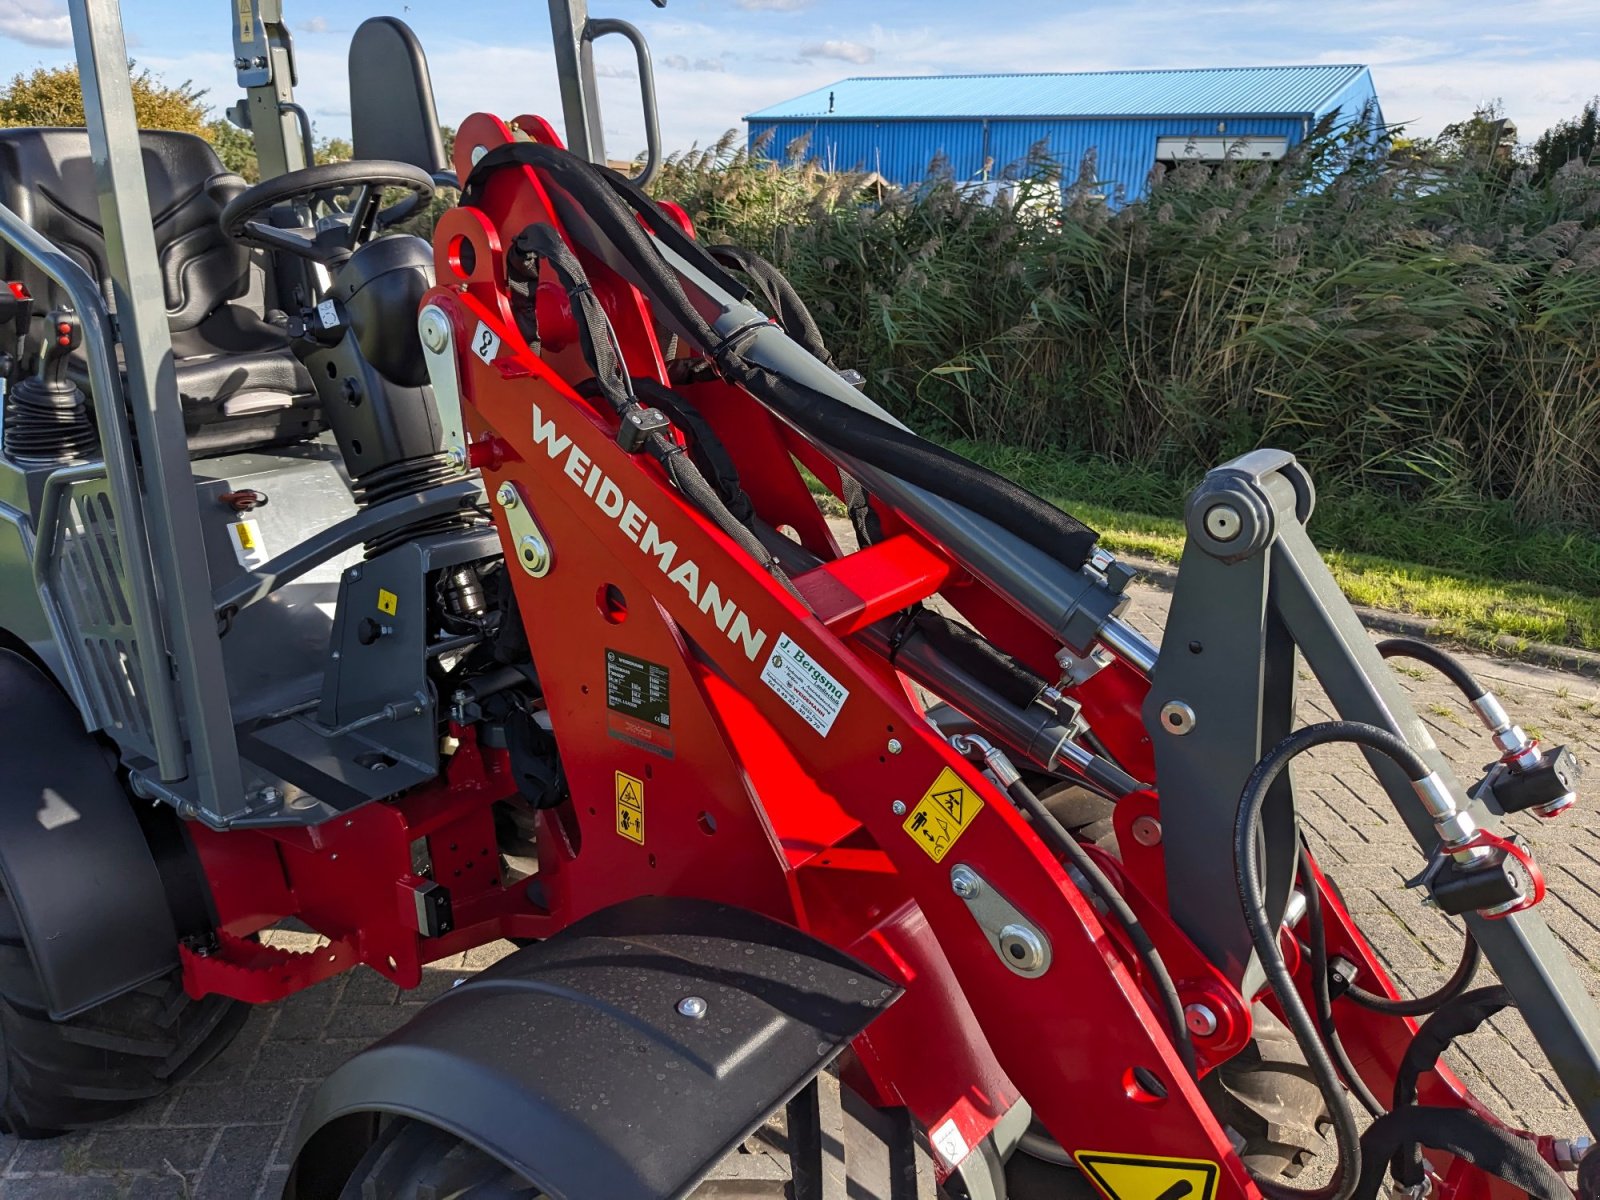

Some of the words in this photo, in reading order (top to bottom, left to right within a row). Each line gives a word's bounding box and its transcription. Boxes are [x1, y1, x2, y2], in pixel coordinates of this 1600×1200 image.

[533, 402, 767, 662] WEIDEMANN
[780, 639, 791, 653] J.
[793, 649, 843, 699] Bergsma
[792, 685, 825, 717] WEIDEMANN
